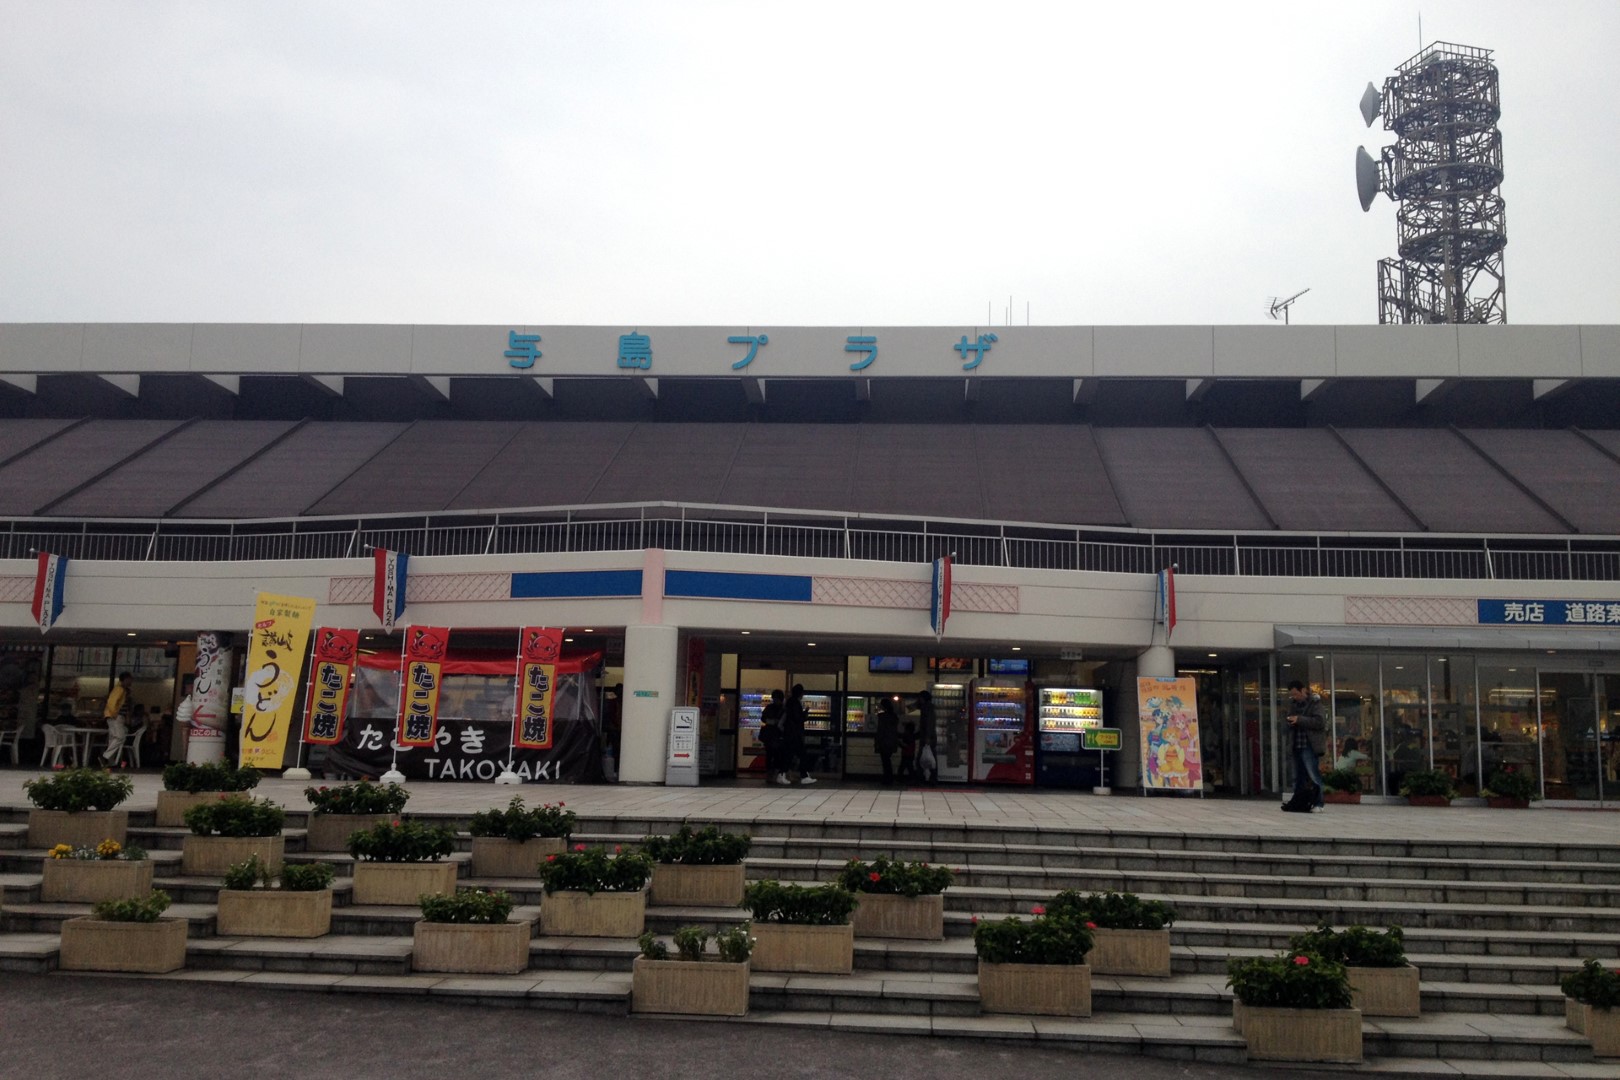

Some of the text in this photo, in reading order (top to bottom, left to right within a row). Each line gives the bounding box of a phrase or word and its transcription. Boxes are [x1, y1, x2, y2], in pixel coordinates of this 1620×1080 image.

[504, 330, 998, 370] 与島プラザ
[41, 562, 54, 627] YOSHIMA PLAZA
[385, 599, 393, 627] PLAZA
[1504, 602, 1544, 622] 売店
[196, 647, 212, 694] うどん
[244, 649, 281, 742] うどん
[311, 663, 343, 738] たこ焼
[405, 662, 435, 740] たこ焼
[522, 664, 550, 742] たこ焼
